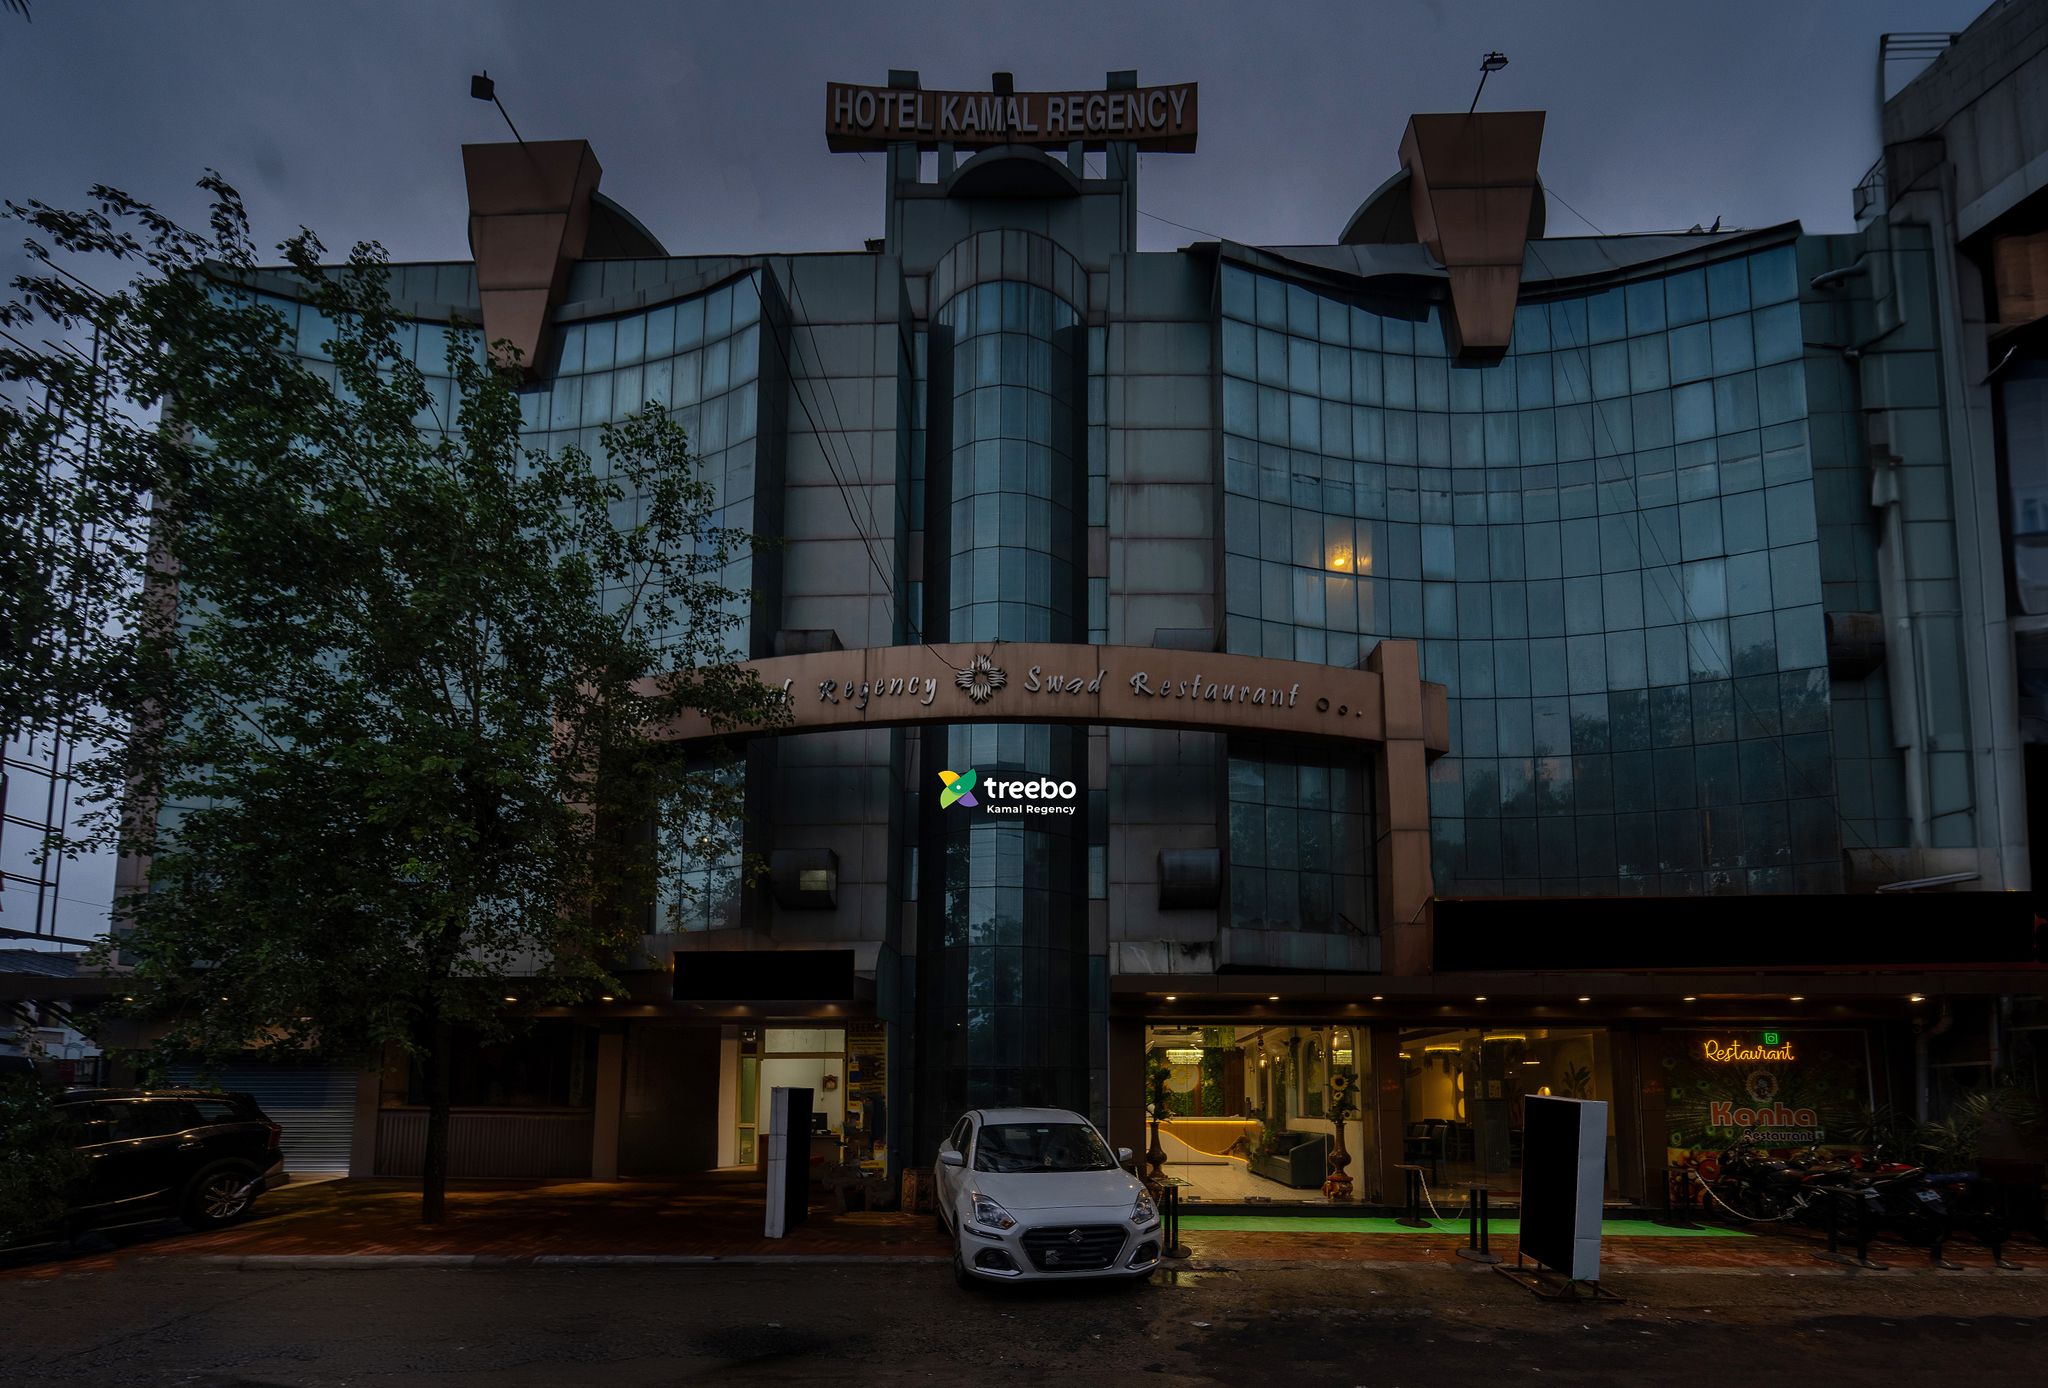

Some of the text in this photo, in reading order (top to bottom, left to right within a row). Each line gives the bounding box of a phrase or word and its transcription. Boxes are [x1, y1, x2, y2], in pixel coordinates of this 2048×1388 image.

[834, 88, 1188, 133] HOTEL KAMAL REGENCY
[818, 675, 938, 709] Regency
[1024, 665, 1300, 708] Swad Restaurant
[983, 777, 1077, 799] treebo
[986, 804, 1076, 815] Kamal Regency
[1704, 1039, 1795, 1062] Restaurant
[1710, 1101, 1818, 1127] Kanha
